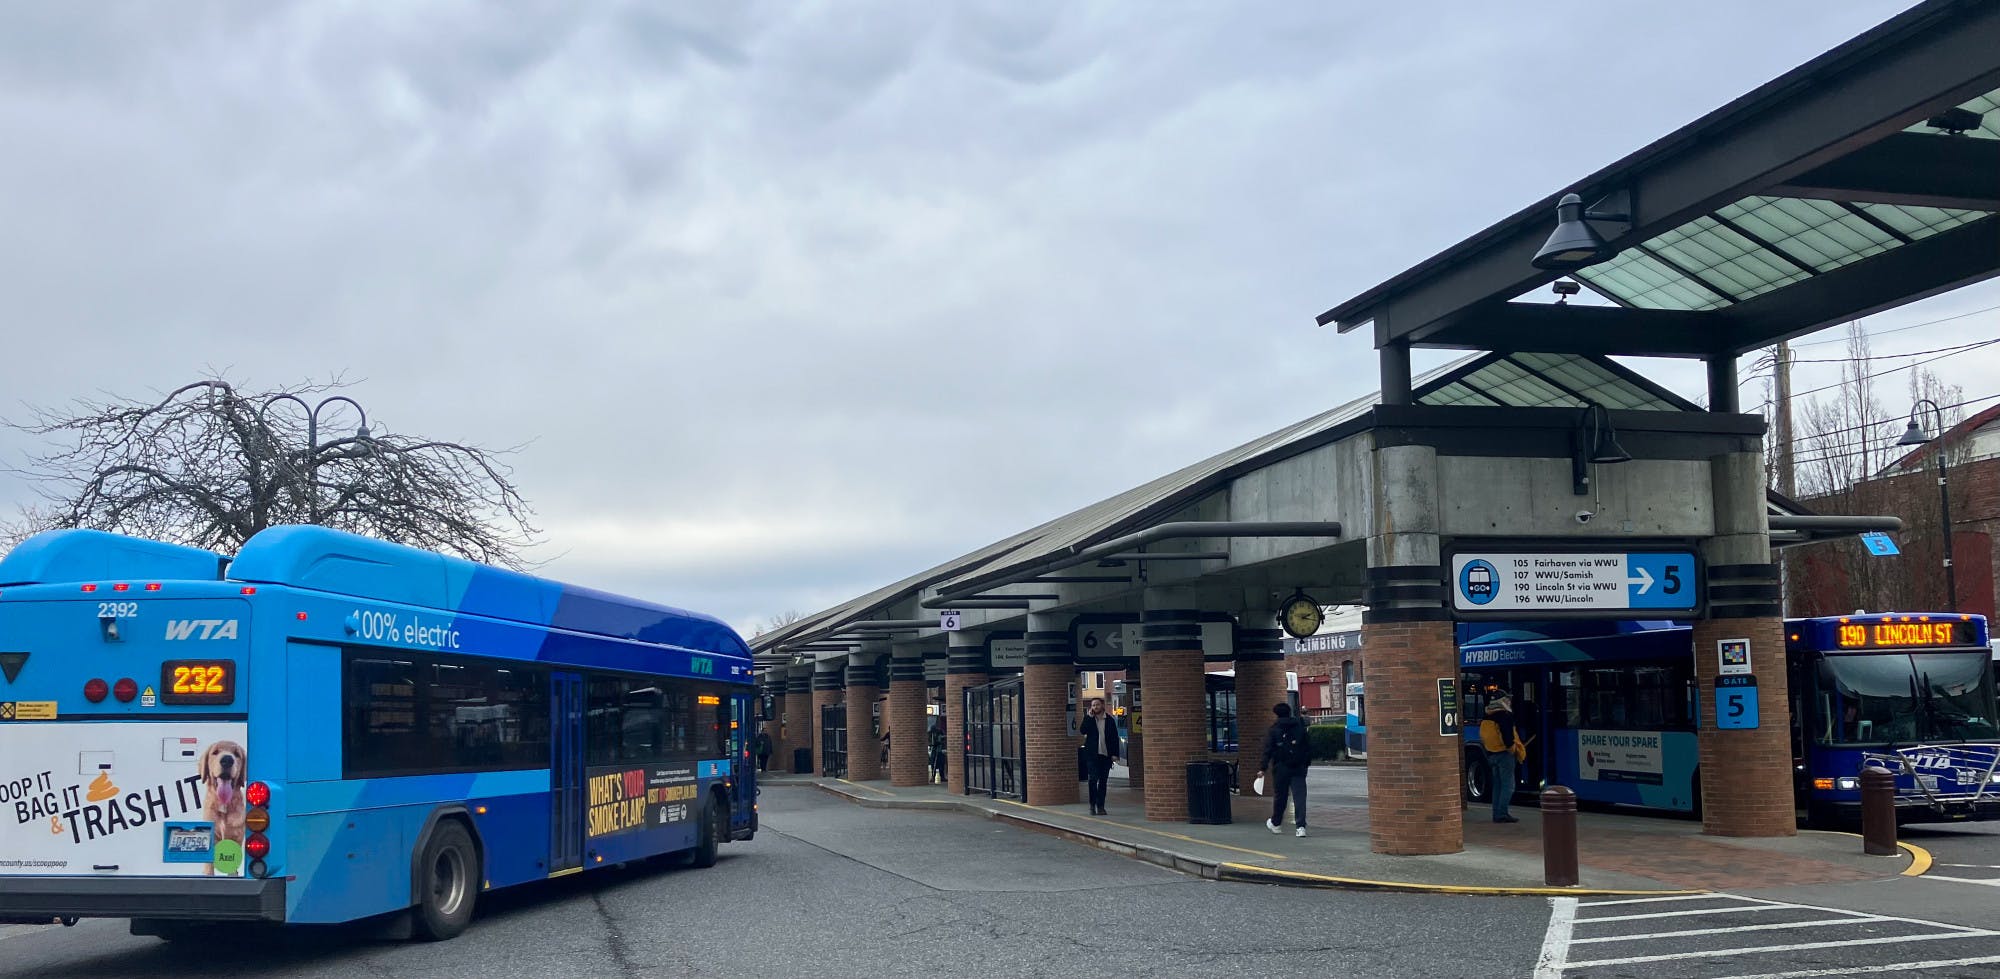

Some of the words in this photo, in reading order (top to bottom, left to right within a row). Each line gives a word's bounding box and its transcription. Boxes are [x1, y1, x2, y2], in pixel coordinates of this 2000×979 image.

[1874, 539, 1888, 552] 5
[1513, 559, 1529, 567] 105
[1534, 559, 1577, 567] Fairhaven
[1579, 559, 1592, 567] via
[1594, 559, 1618, 567] WWU
[1514, 571, 1529, 579] 107
[1534, 570, 1594, 581] WWU/Samish
[1663, 565, 1681, 594] 5
[1474, 584, 1486, 592] GO
[1514, 583, 1530, 591] 190
[1535, 582, 1565, 591] Lincoln
[1567, 582, 1576, 591] St
[1578, 582, 1591, 591] via
[1592, 582, 1617, 591] WWU
[1515, 595, 1531, 603] 196
[1536, 594, 1594, 605] WWU/Lincoln
[97, 602, 138, 618] 2392
[165, 619, 238, 640] WTA
[353, 609, 400, 642] 100%
[404, 615, 460, 649] electric
[946, 617, 955, 628] 6
[1083, 630, 1098, 649] 6
[1839, 625, 1866, 646] 190
[1874, 624, 1932, 645] LINCOLN
[1935, 623, 1952, 644] ST
[795, 656, 801, 665] 7
[1465, 650, 1498, 664] HYBRID
[1500, 649, 1526, 661] Electric
[691, 656, 713, 675] WTA
[173, 666, 225, 694] 232
[1728, 694, 1745, 717] 5
[874, 724, 880, 734] 7
[1581, 734, 1606, 746] SHARE
[1608, 735, 1630, 747] YOUR
[1631, 736, 1659, 749] SPARE
[36, 770, 51, 792] IT
[589, 772, 622, 806] WHAT'S
[623, 769, 645, 799] YOUR
[15, 792, 59, 824] BAG
[62, 784, 80, 810] IT
[51, 815, 65, 835] &
[62, 785, 170, 844] TRASH
[175, 774, 202, 813] IT
[588, 802, 619, 837] SMOKE
[620, 796, 646, 829] PLAN?
[219, 853, 235, 861] Axel
